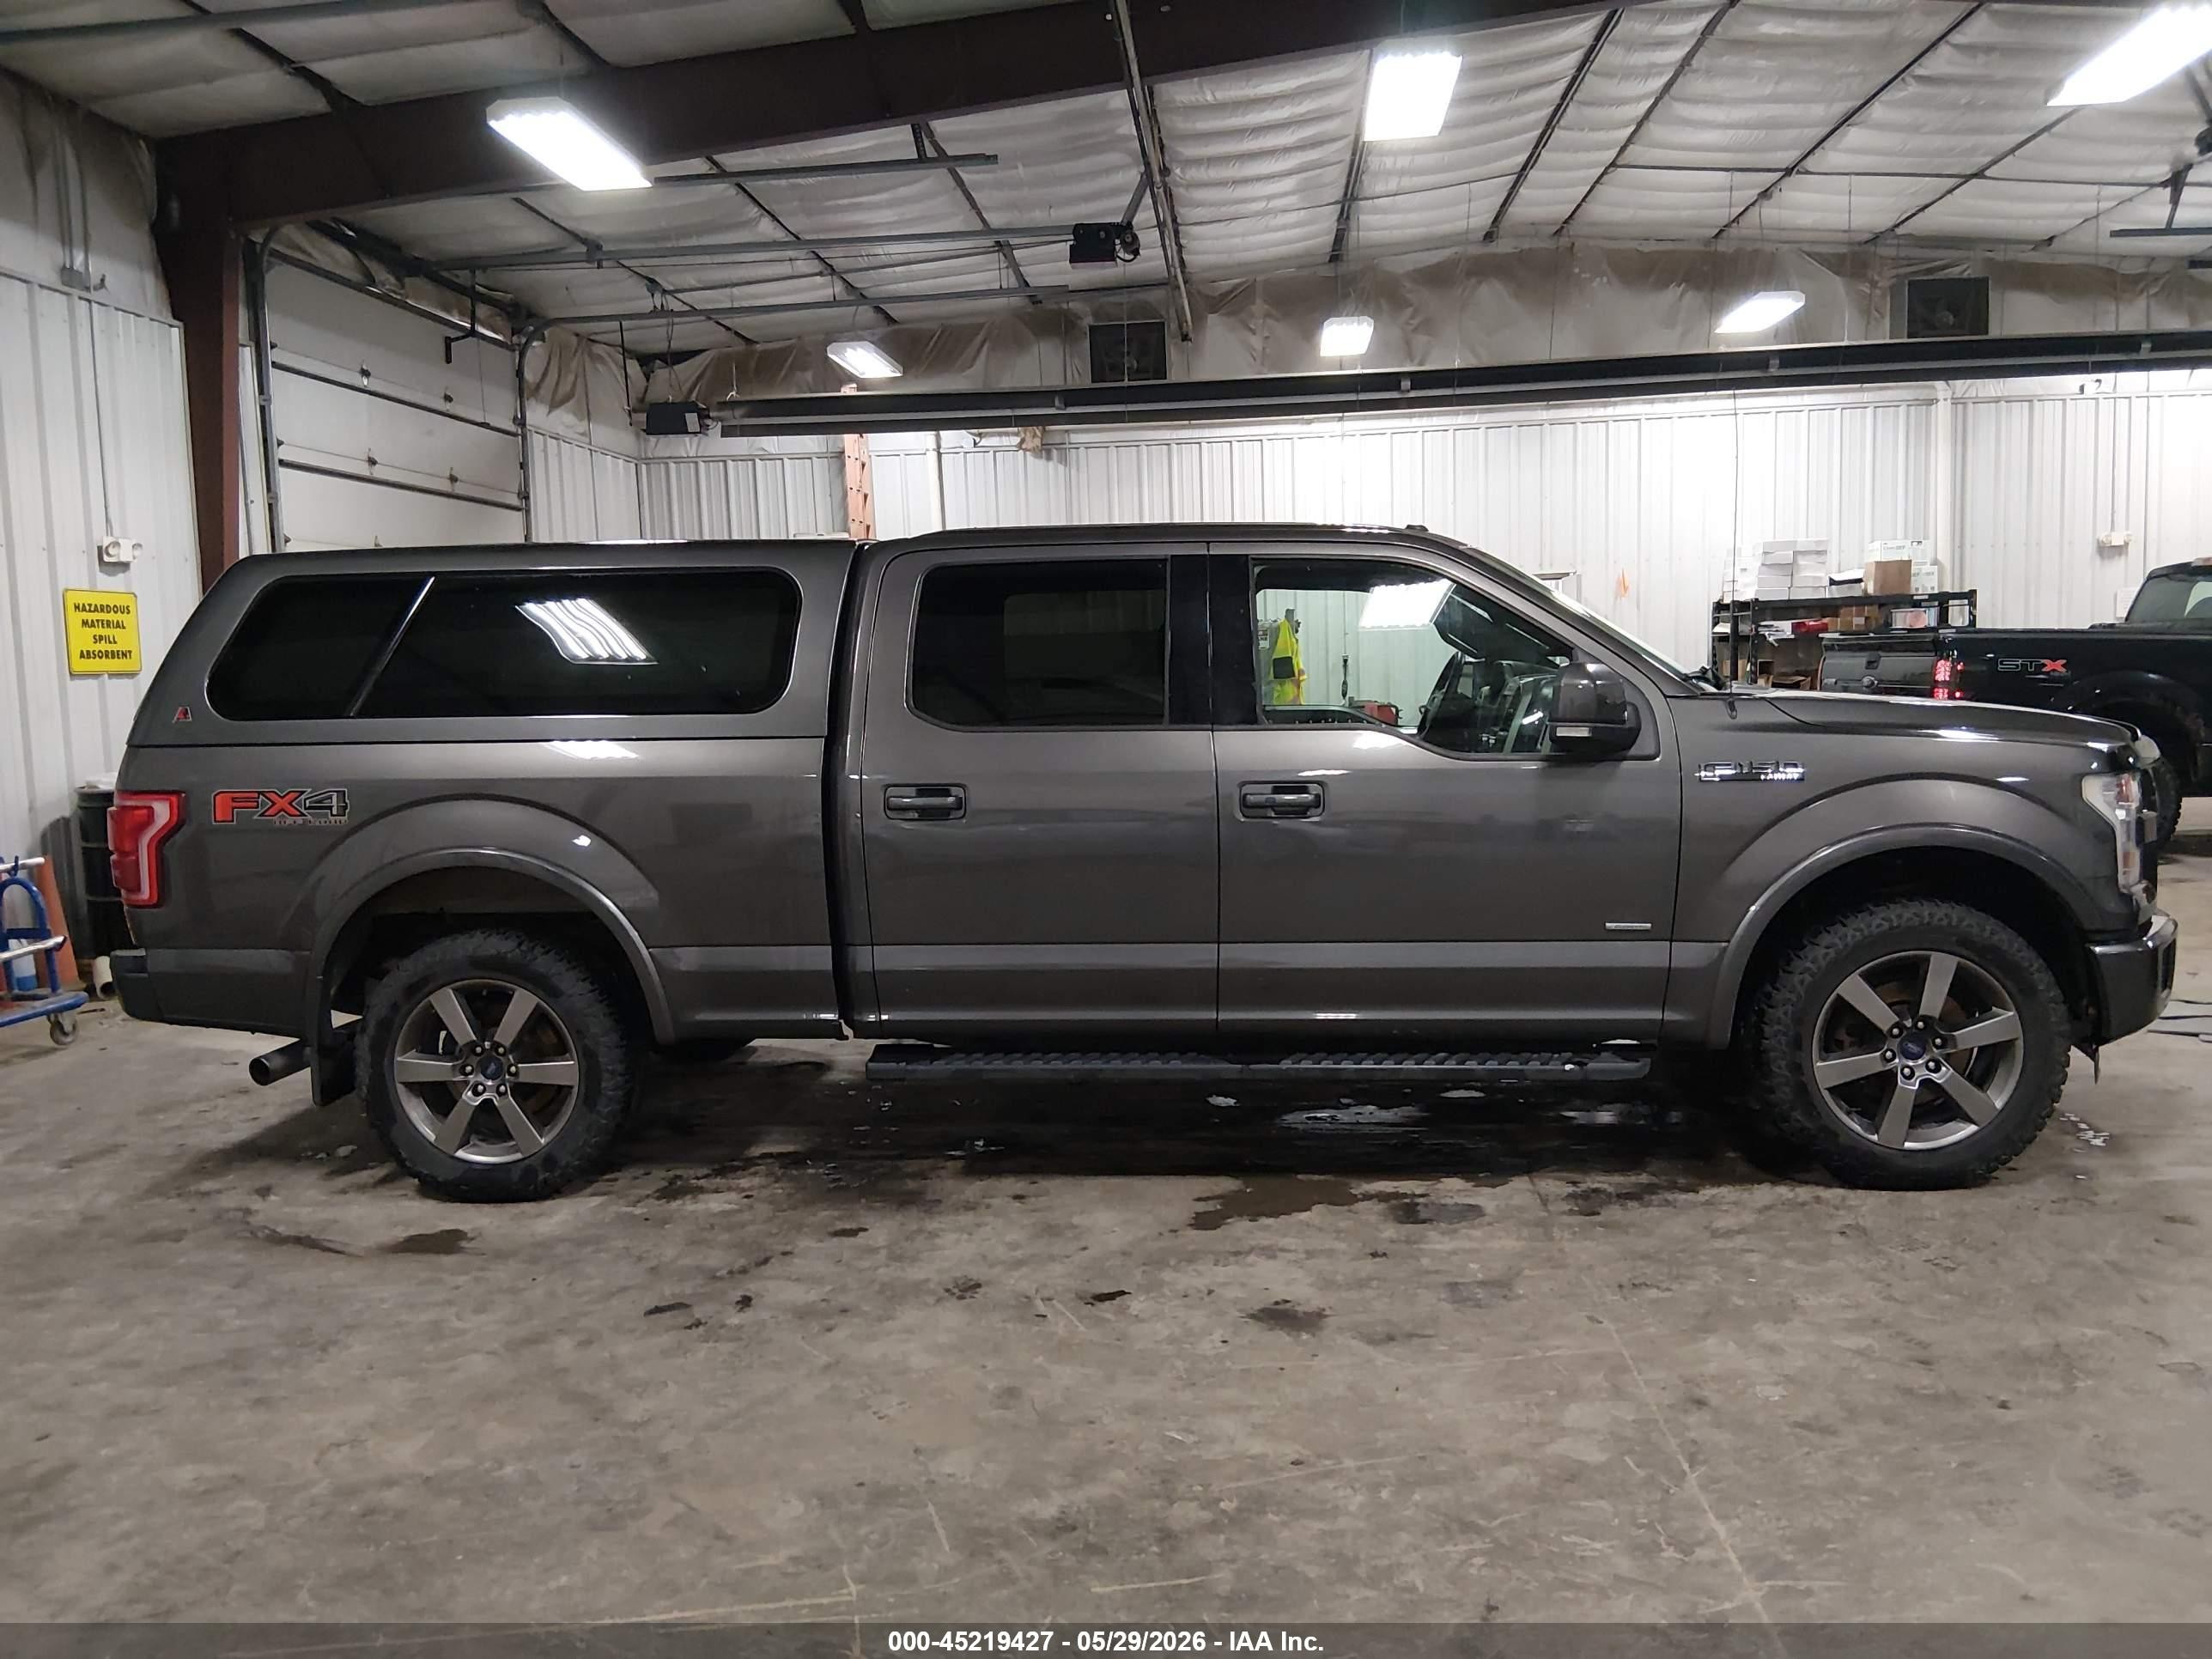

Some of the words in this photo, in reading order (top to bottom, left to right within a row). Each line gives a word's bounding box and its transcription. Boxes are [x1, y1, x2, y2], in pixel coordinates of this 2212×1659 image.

[73, 602, 131, 615] HAZARDOUS
[81, 618, 126, 629] MATERIAL
[92, 634, 118, 645] SPILL
[79, 649, 133, 660] ABSORBENT
[1997, 658, 2068, 673] STX
[212, 788, 350, 824] FX4
